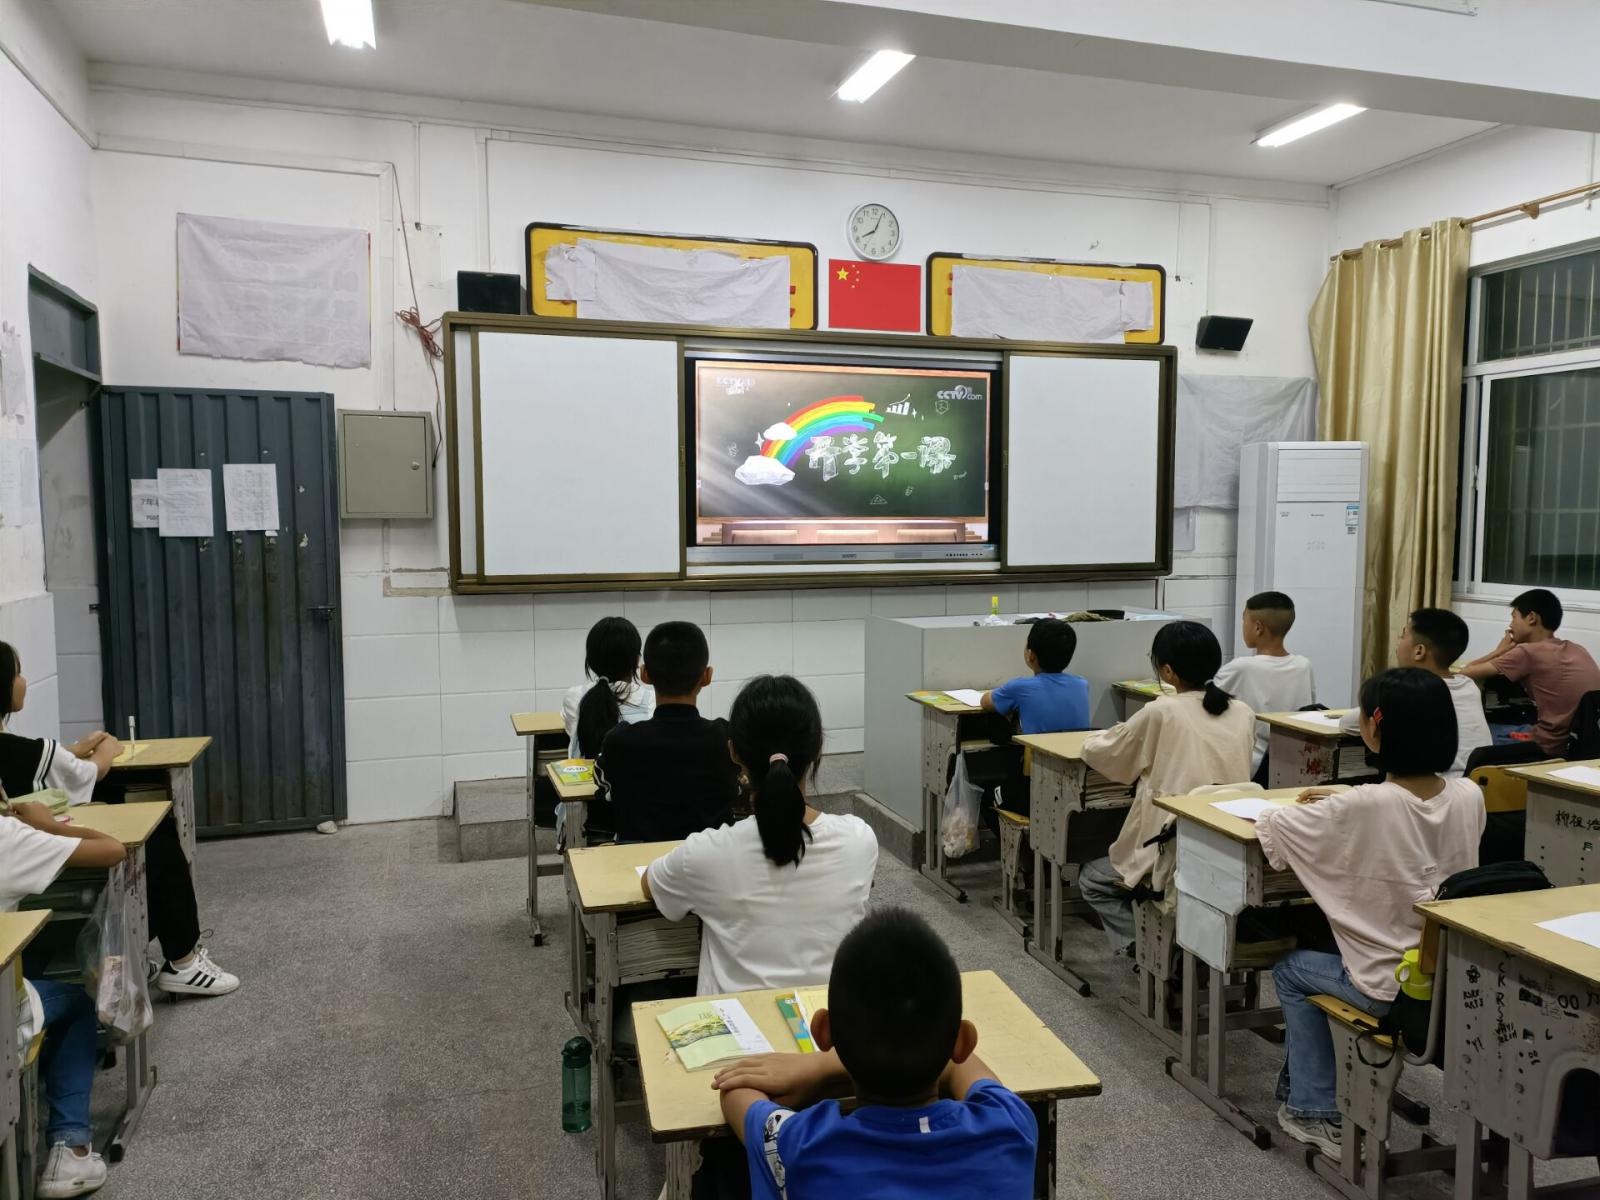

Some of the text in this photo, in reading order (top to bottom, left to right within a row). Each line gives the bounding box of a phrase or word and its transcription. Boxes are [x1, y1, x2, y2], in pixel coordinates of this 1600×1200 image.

[863, 209, 870, 217] 11
[872, 208, 879, 216] 12
[857, 216, 864, 224] 10
[805, 431, 957, 482] 开学第一课
